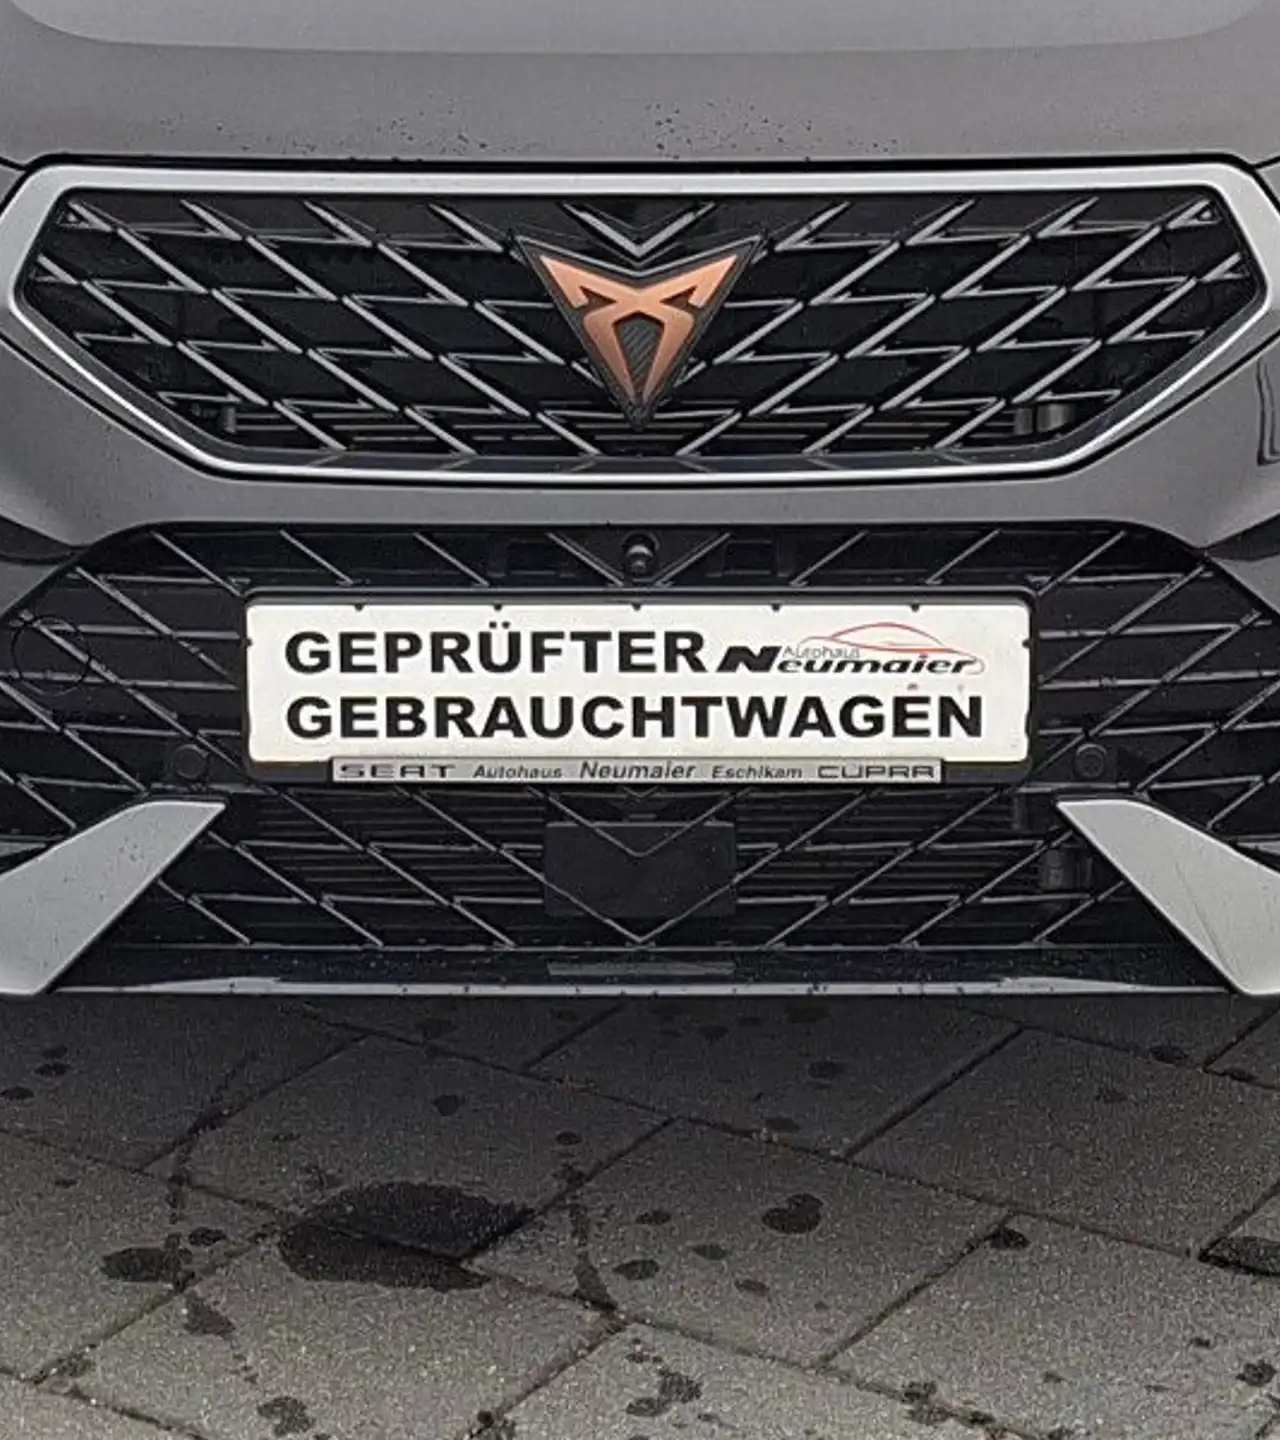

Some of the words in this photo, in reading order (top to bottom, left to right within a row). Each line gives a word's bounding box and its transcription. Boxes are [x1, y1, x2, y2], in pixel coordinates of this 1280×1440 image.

[286, 622, 705, 673] GEPRÜFTER
[715, 644, 978, 675] Neumaier
[286, 695, 982, 738] GEBRAUCHTWAGEN
[339, 765, 456, 778] SEAT
[473, 765, 563, 779] Autohaus
[580, 761, 696, 780] Neumaier
[711, 766, 803, 780] Eschlkam
[818, 766, 935, 779] CUPRA
